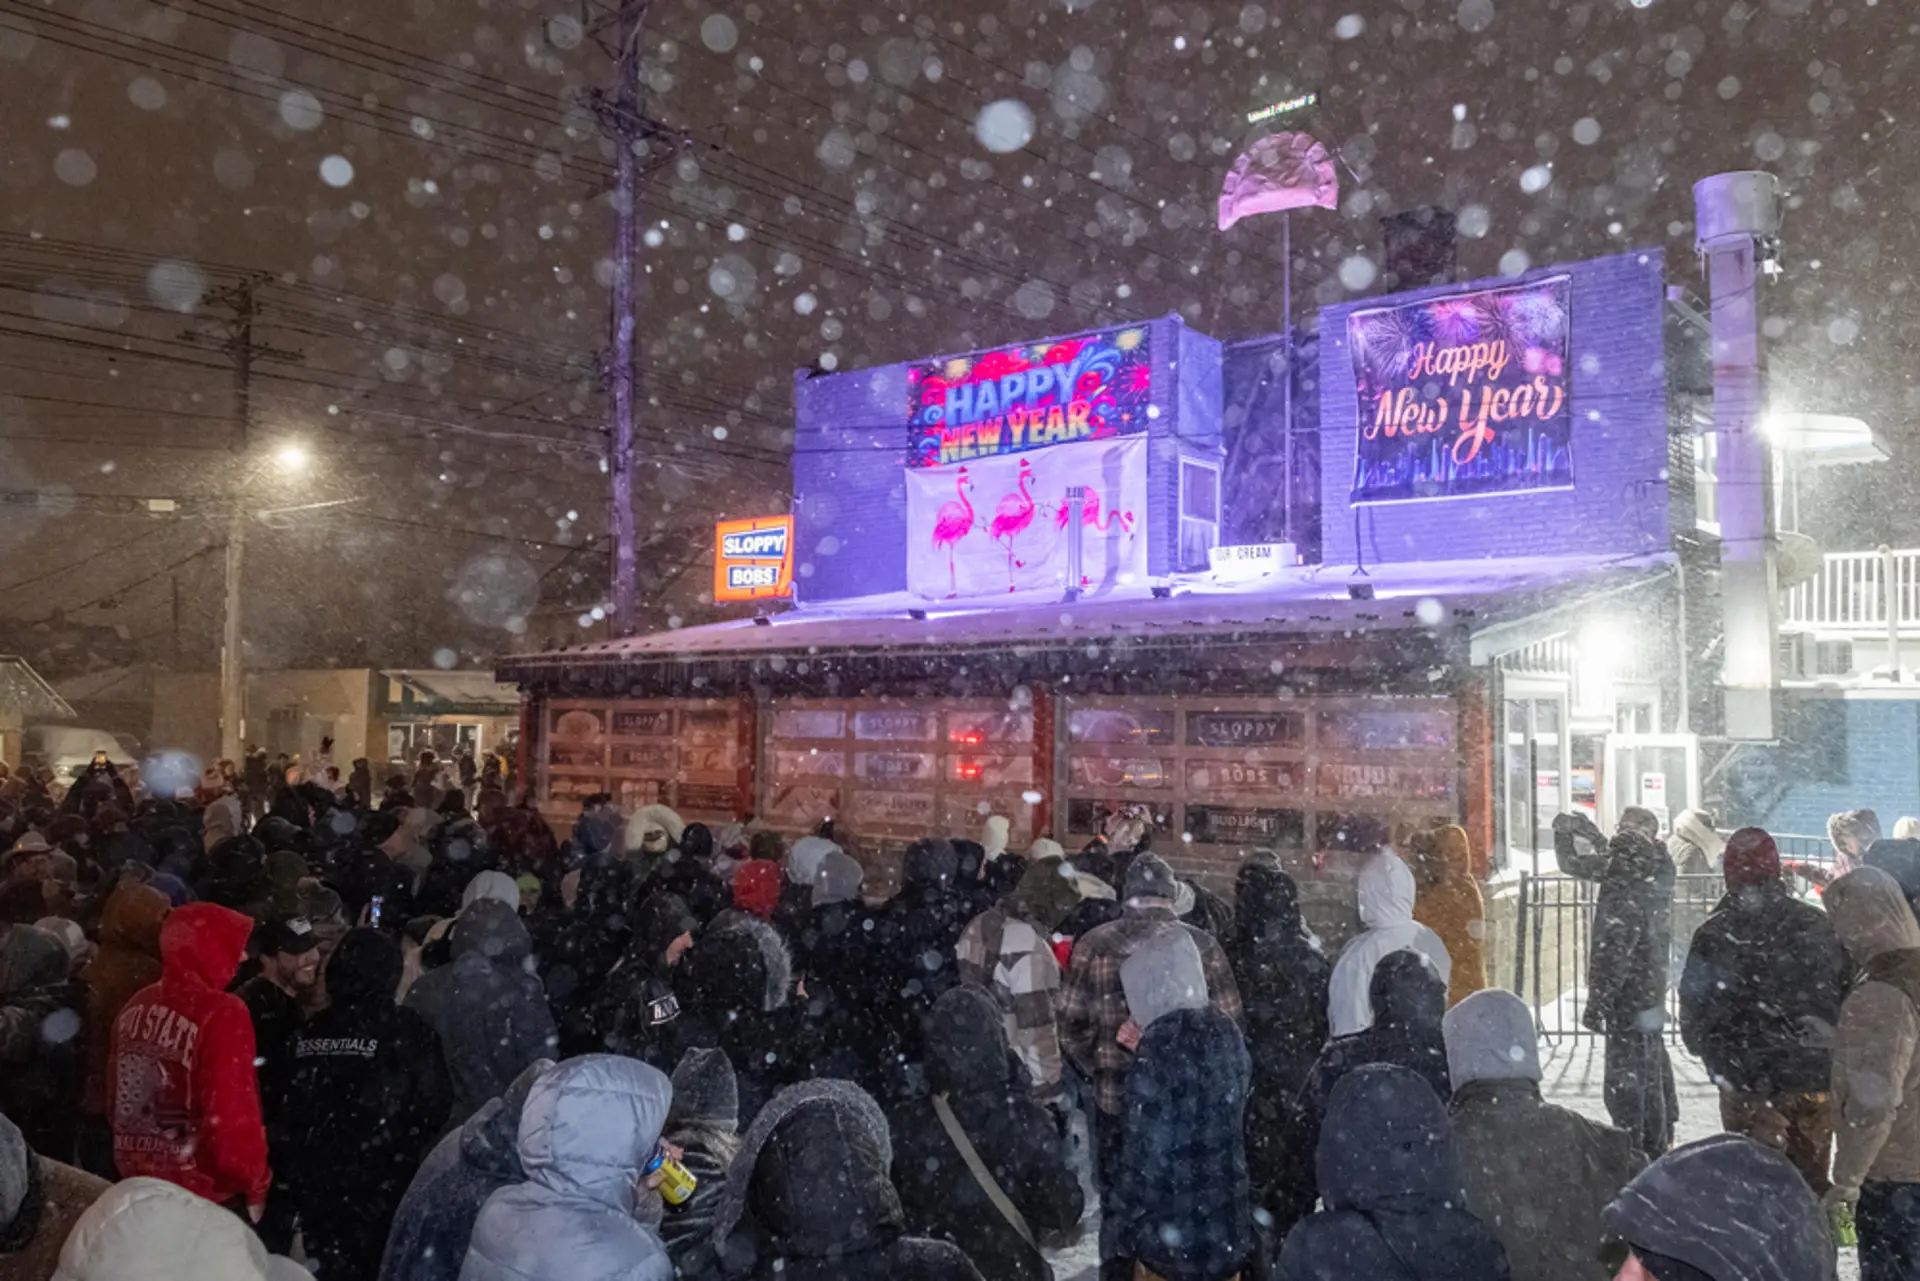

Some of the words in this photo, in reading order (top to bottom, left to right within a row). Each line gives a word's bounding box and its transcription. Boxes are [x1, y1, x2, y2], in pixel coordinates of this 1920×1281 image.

[1408, 339, 1509, 386] Happy
[945, 358, 1083, 426] HAPPY
[1363, 387, 1448, 440] New
[1452, 374, 1563, 465] Year
[939, 414, 1004, 464] NEW
[1006, 399, 1092, 450] YEAR
[724, 535, 785, 553] SLOPPY
[1236, 546, 1272, 560] CREAM
[732, 567, 773, 585] BOBS
[1209, 721, 1277, 738] SLOPPY
[1221, 767, 1267, 783] BOBS
[1211, 814, 1238, 829] BUD
[142, 1003, 198, 1069] STATE
[298, 1038, 378, 1052] ESSENTIALS
